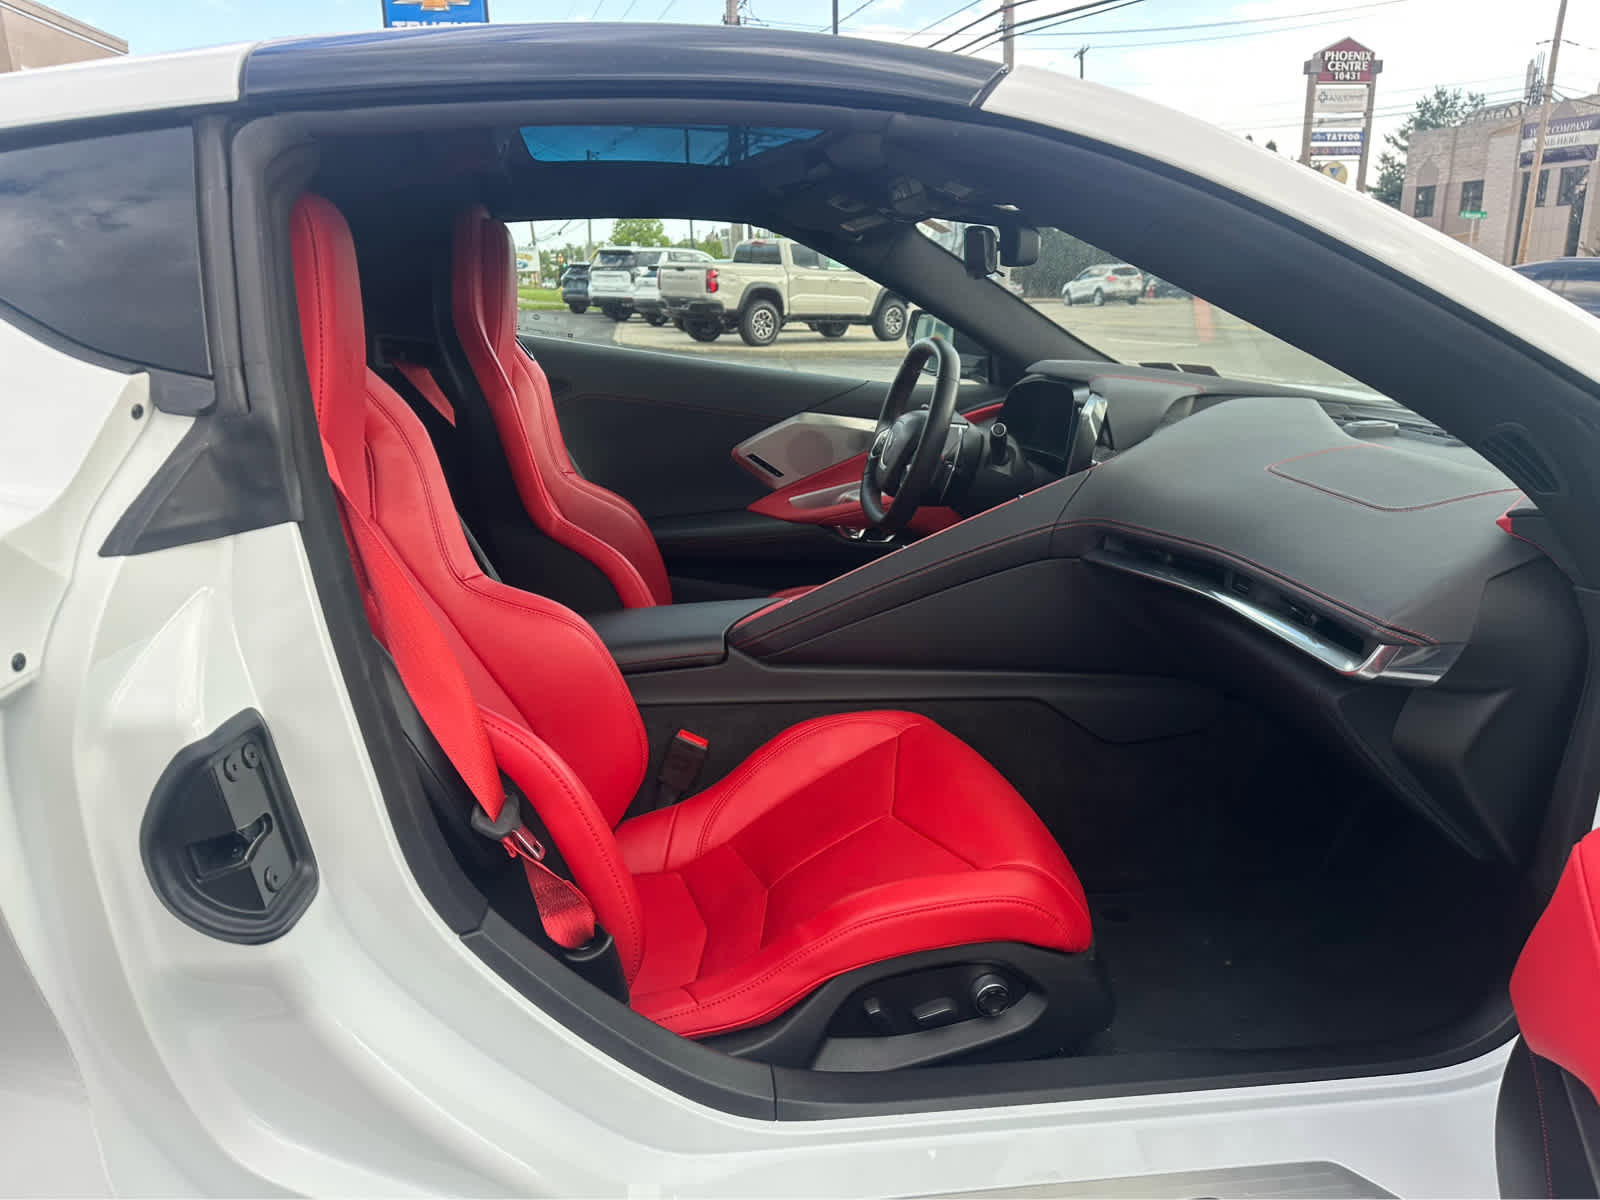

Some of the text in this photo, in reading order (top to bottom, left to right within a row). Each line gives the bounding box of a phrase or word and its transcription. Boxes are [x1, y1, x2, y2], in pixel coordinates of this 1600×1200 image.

[1324, 50, 1372, 61] PHOENIX
[1327, 60, 1369, 71] CENTRE
[1334, 71, 1361, 81] 10431
[1326, 132, 1361, 141] TATTOO
